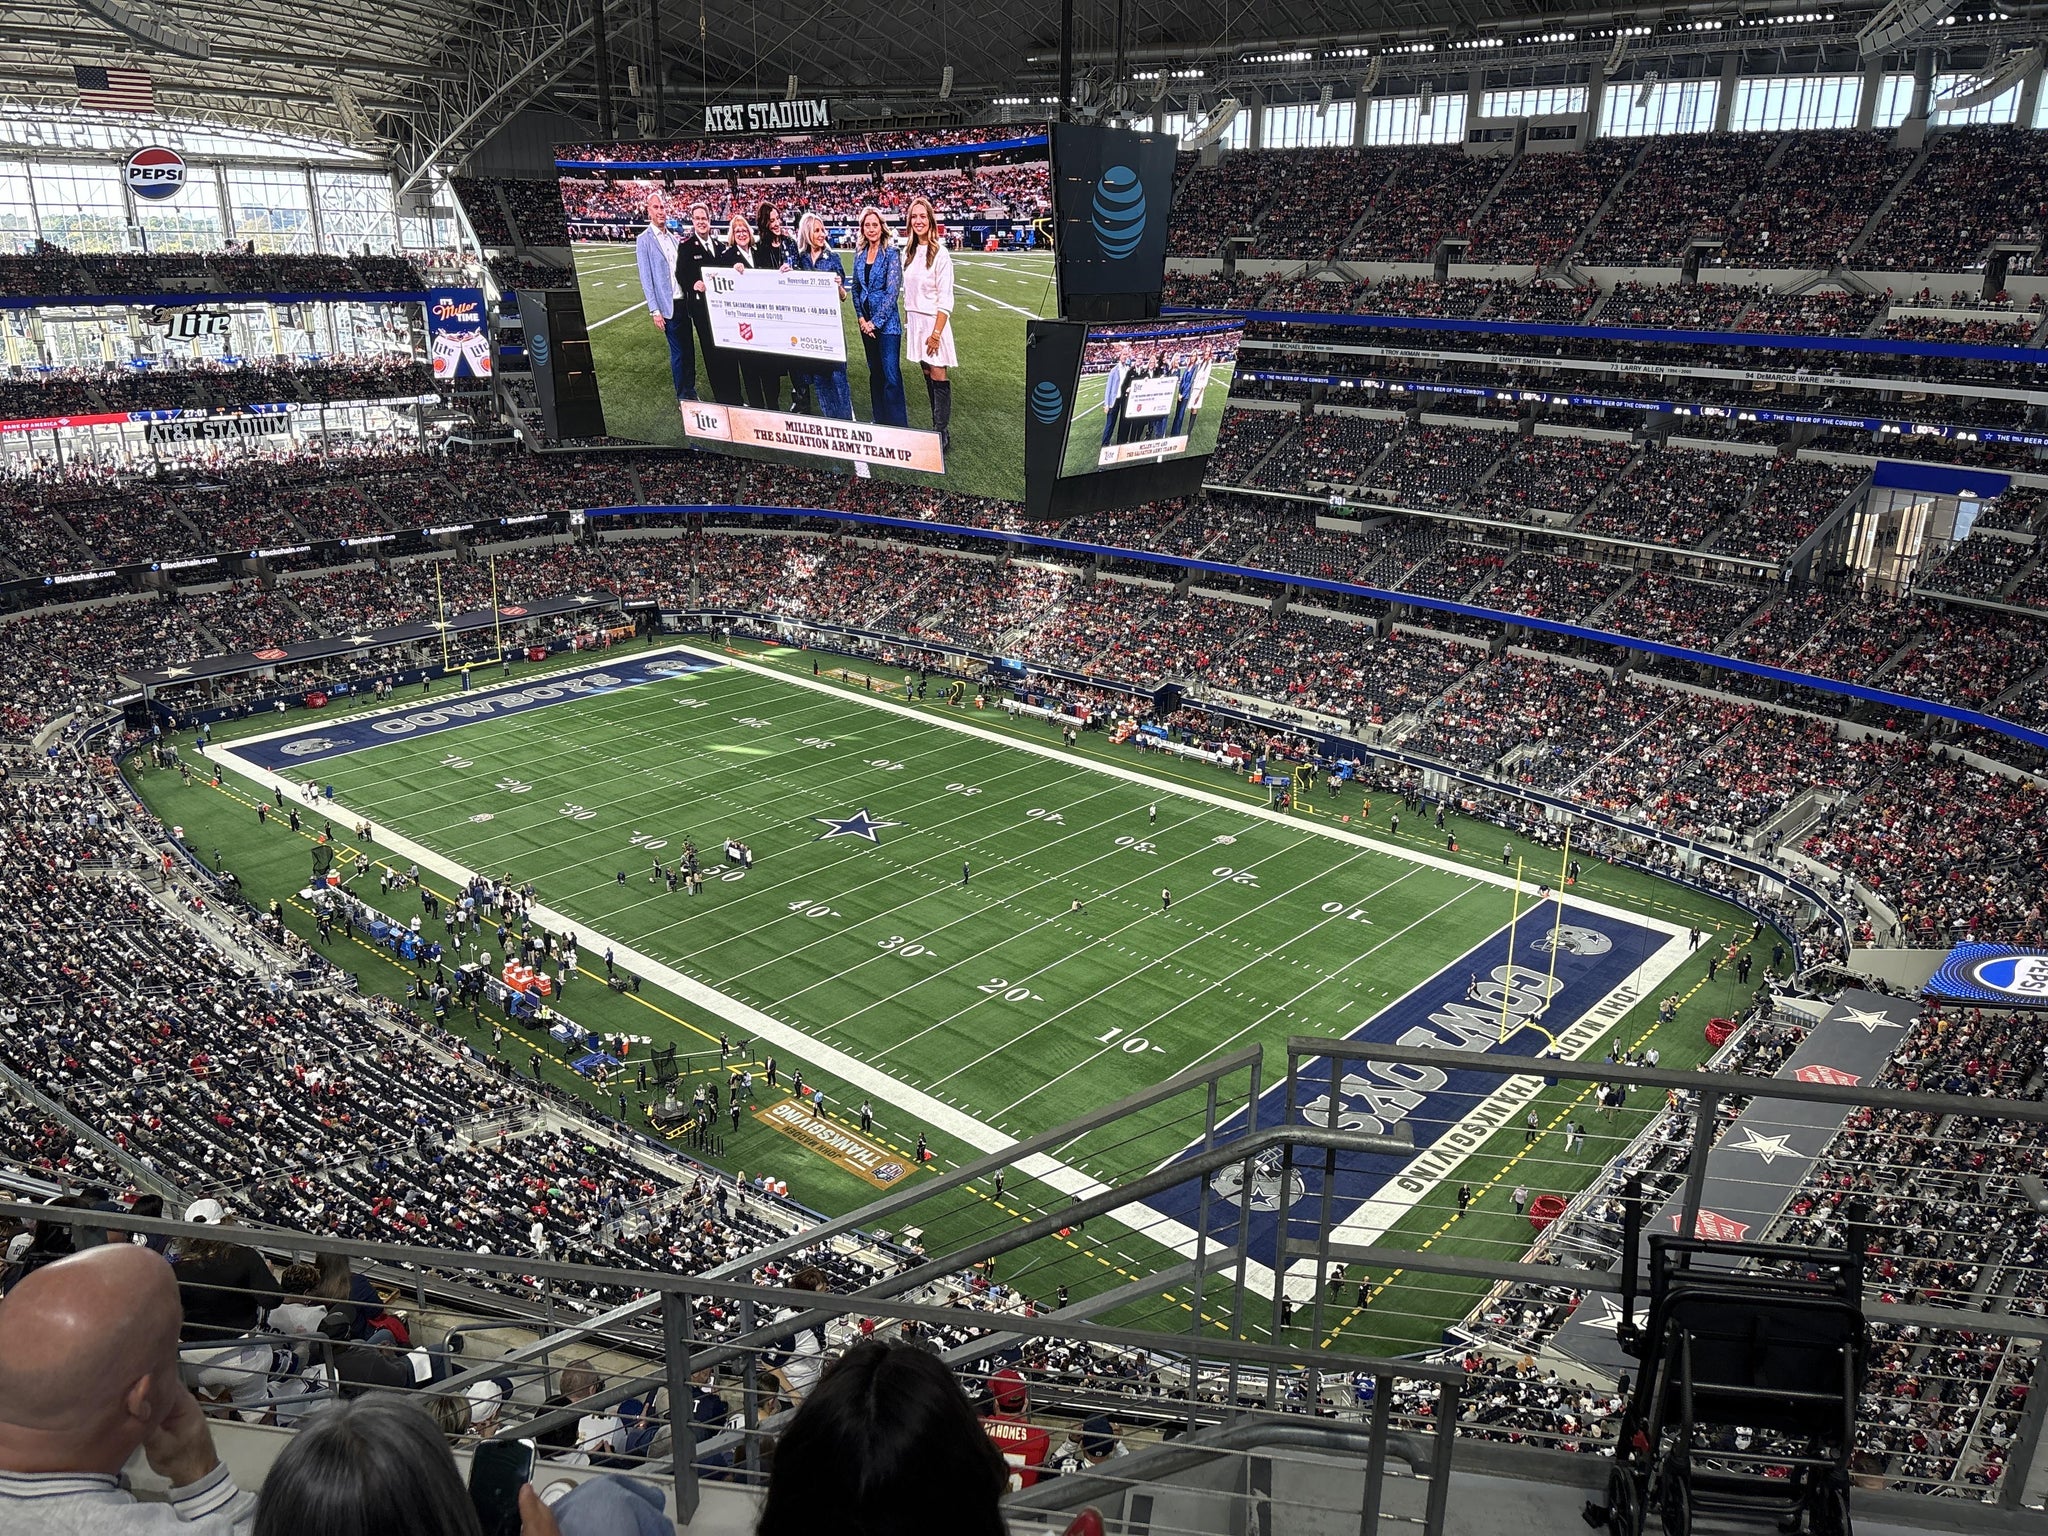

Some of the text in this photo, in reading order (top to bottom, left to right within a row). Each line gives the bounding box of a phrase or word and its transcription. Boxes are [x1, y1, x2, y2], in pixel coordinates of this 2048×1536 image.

[705, 100, 830, 132] AT&T STADIUM
[130, 168, 183, 181] PEPSI
[713, 276, 735, 294] Lite
[432, 302, 478, 321] Miller
[457, 313, 480, 322] TIME
[166, 313, 231, 341] Lite
[433, 342, 455, 356] Lite
[470, 342, 490, 358] Lite
[1499, 356, 1521, 364] EMMITT
[1756, 374, 1795, 382] DeMARCUS
[151, 411, 157, 420] 0
[184, 409, 208, 418] 27:01
[272, 404, 278, 412] 0
[695, 411, 717, 431] Lite
[1835, 420, 1865, 428] COWBOYS
[149, 416, 290, 444] AT&T STADIUM
[785, 421, 873, 442] MILLER LITE AND
[754, 429, 912, 462] THE SALVATION ARMY TEAM UP
[1997, 434, 2010, 442] THE
[2023, 437, 2043, 445] BEER
[507, 513, 548, 525] Blockchain.com
[429, 524, 474, 535] Blockchain.com
[348, 535, 396, 546] Blockchain.com
[258, 545, 311, 557] Blockchain.com
[160, 556, 218, 570] Blockchain.com
[54, 569, 117, 584] Blockchain.com
[372, 673, 622, 735] COWBOYS
[678, 698, 710, 708] 10
[329, 710, 382, 725] JOHN
[802, 737, 836, 749] 30
[440, 756, 474, 769] 10
[870, 759, 904, 771] 40
[495, 779, 533, 793] 20
[945, 782, 982, 797] 50
[559, 804, 597, 820] 30
[1025, 807, 1064, 823] 40
[628, 832, 668, 850] 40
[1114, 836, 1156, 853] 30
[702, 863, 746, 882] 50
[1211, 866, 1258, 885] 20
[787, 899, 831, 918] 40
[1321, 902, 1369, 921] 10
[877, 935, 926, 958] 30
[2017, 959, 2048, 994] PEPSI
[977, 977, 1031, 1001] 20
[1094, 1026, 1150, 1054] 10
[1397, 985, 1640, 1194] JOHN MADD THANKSGIVING
[772, 1104, 881, 1167] THANKSGIVING
[782, 1125, 842, 1159] JOHN MADDEN
[984, 1422, 1027, 1441] MAHOMES
